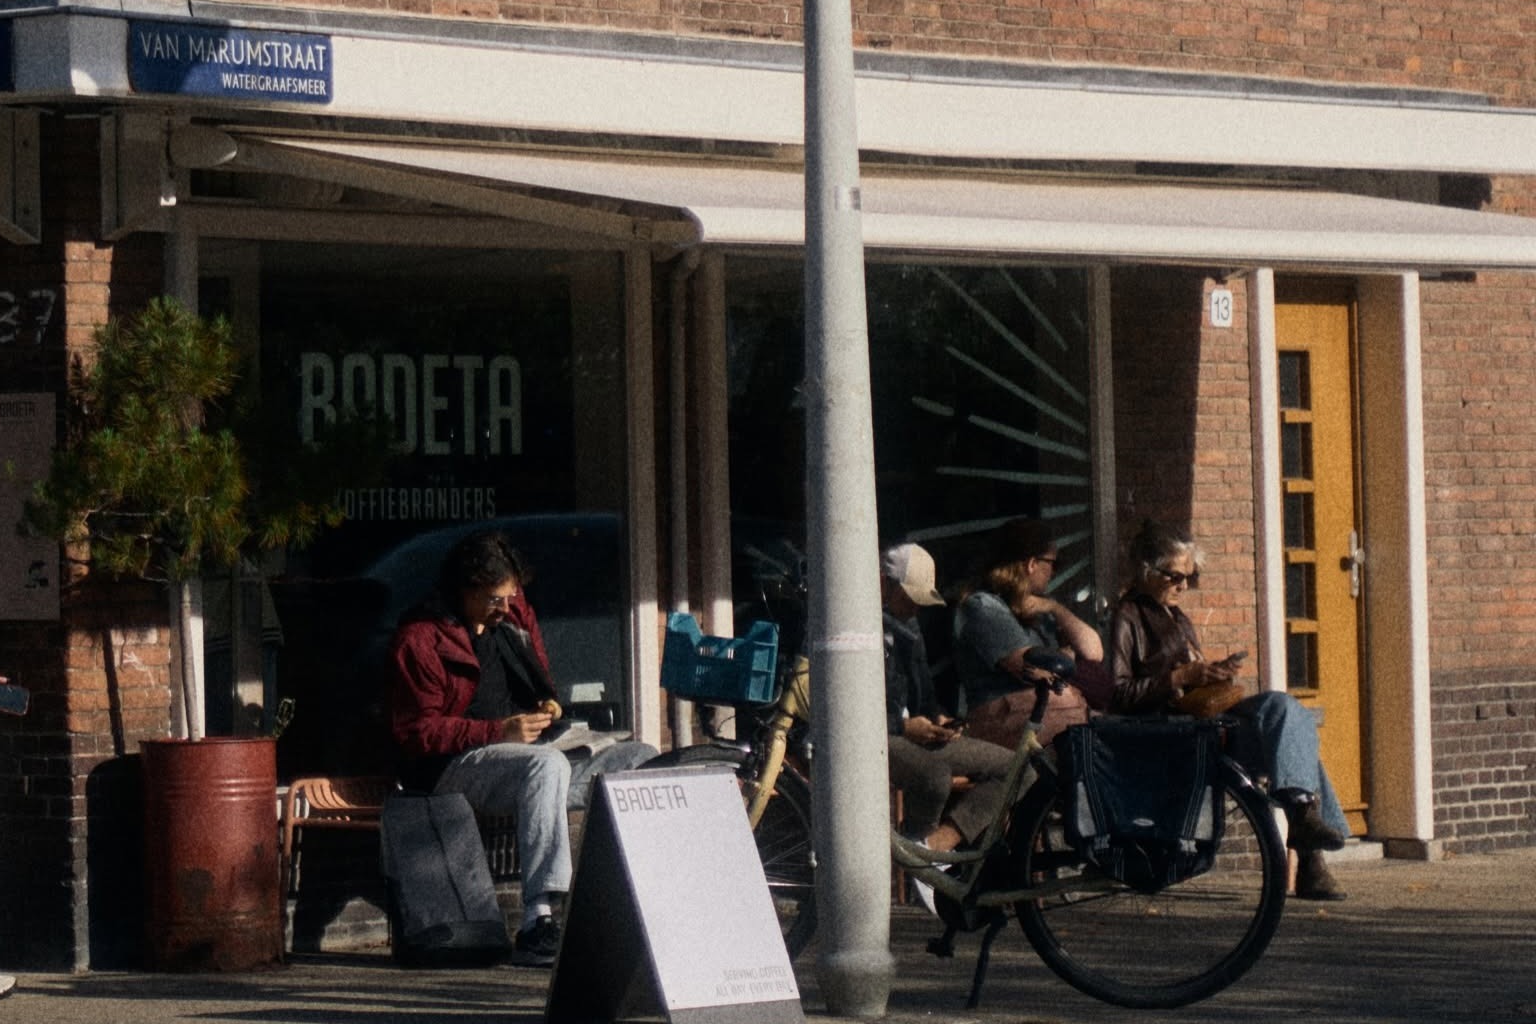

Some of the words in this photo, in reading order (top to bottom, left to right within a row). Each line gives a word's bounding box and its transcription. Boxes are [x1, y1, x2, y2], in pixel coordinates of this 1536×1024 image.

[140, 30, 180, 60] VAN
[188, 36, 327, 72] MARUMSTRAAT
[222, 72, 327, 96] WATERGRAAFSMEER
[1214, 296, 1230, 321] 13
[613, 784, 689, 813] BADETA
